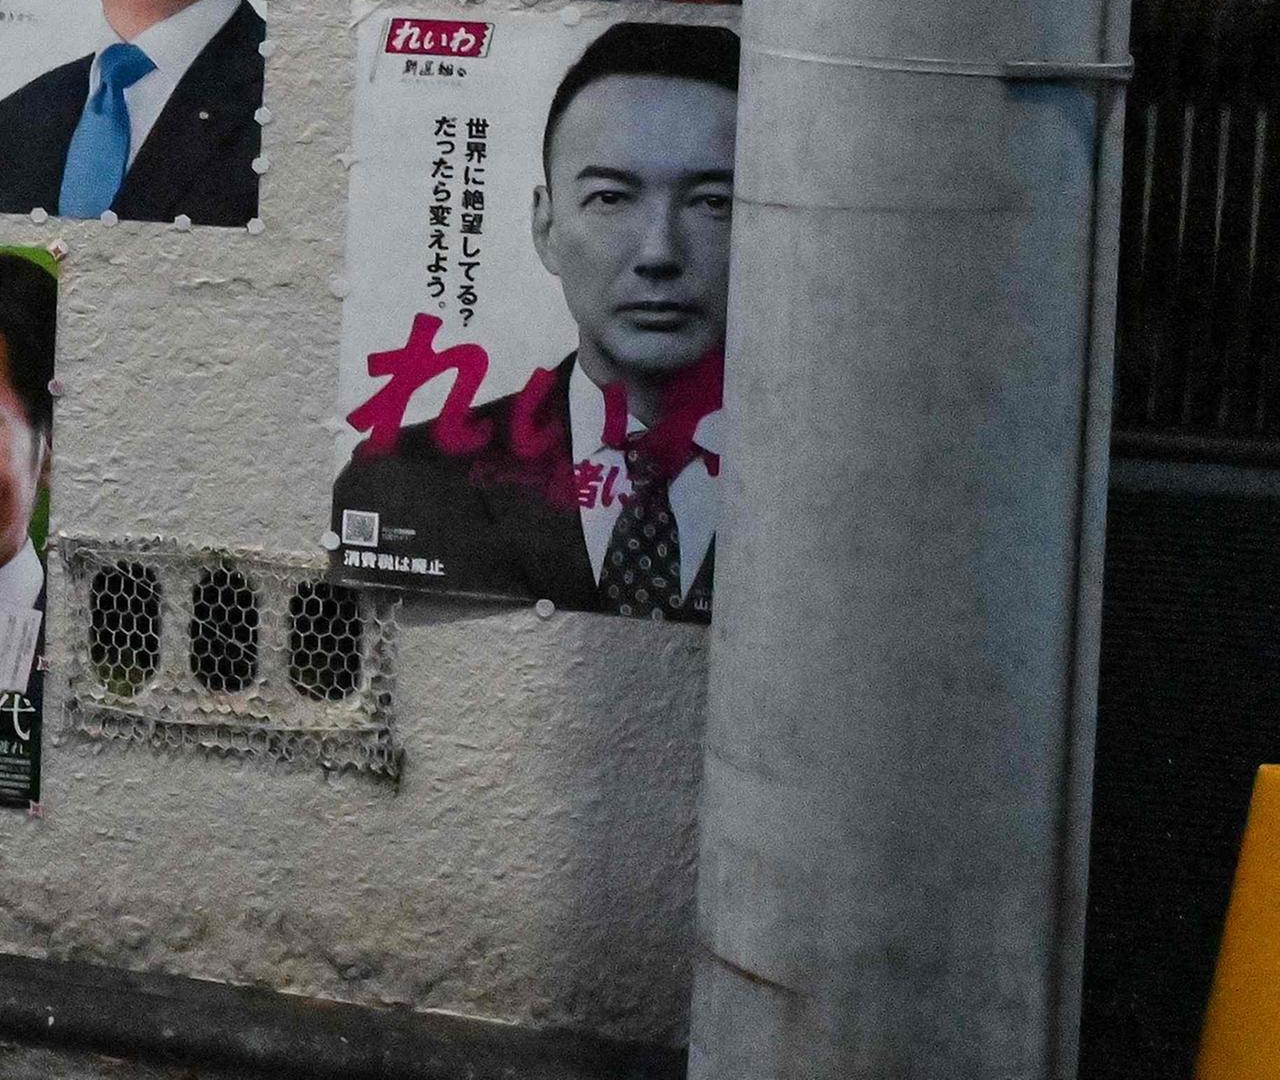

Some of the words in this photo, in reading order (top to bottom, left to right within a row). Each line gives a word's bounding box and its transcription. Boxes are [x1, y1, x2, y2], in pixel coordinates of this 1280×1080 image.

[392, 20, 476, 52] れいわ
[427, 116, 457, 311] だったら変えよう。
[456, 117, 490, 327] 世界に絶望してる?
